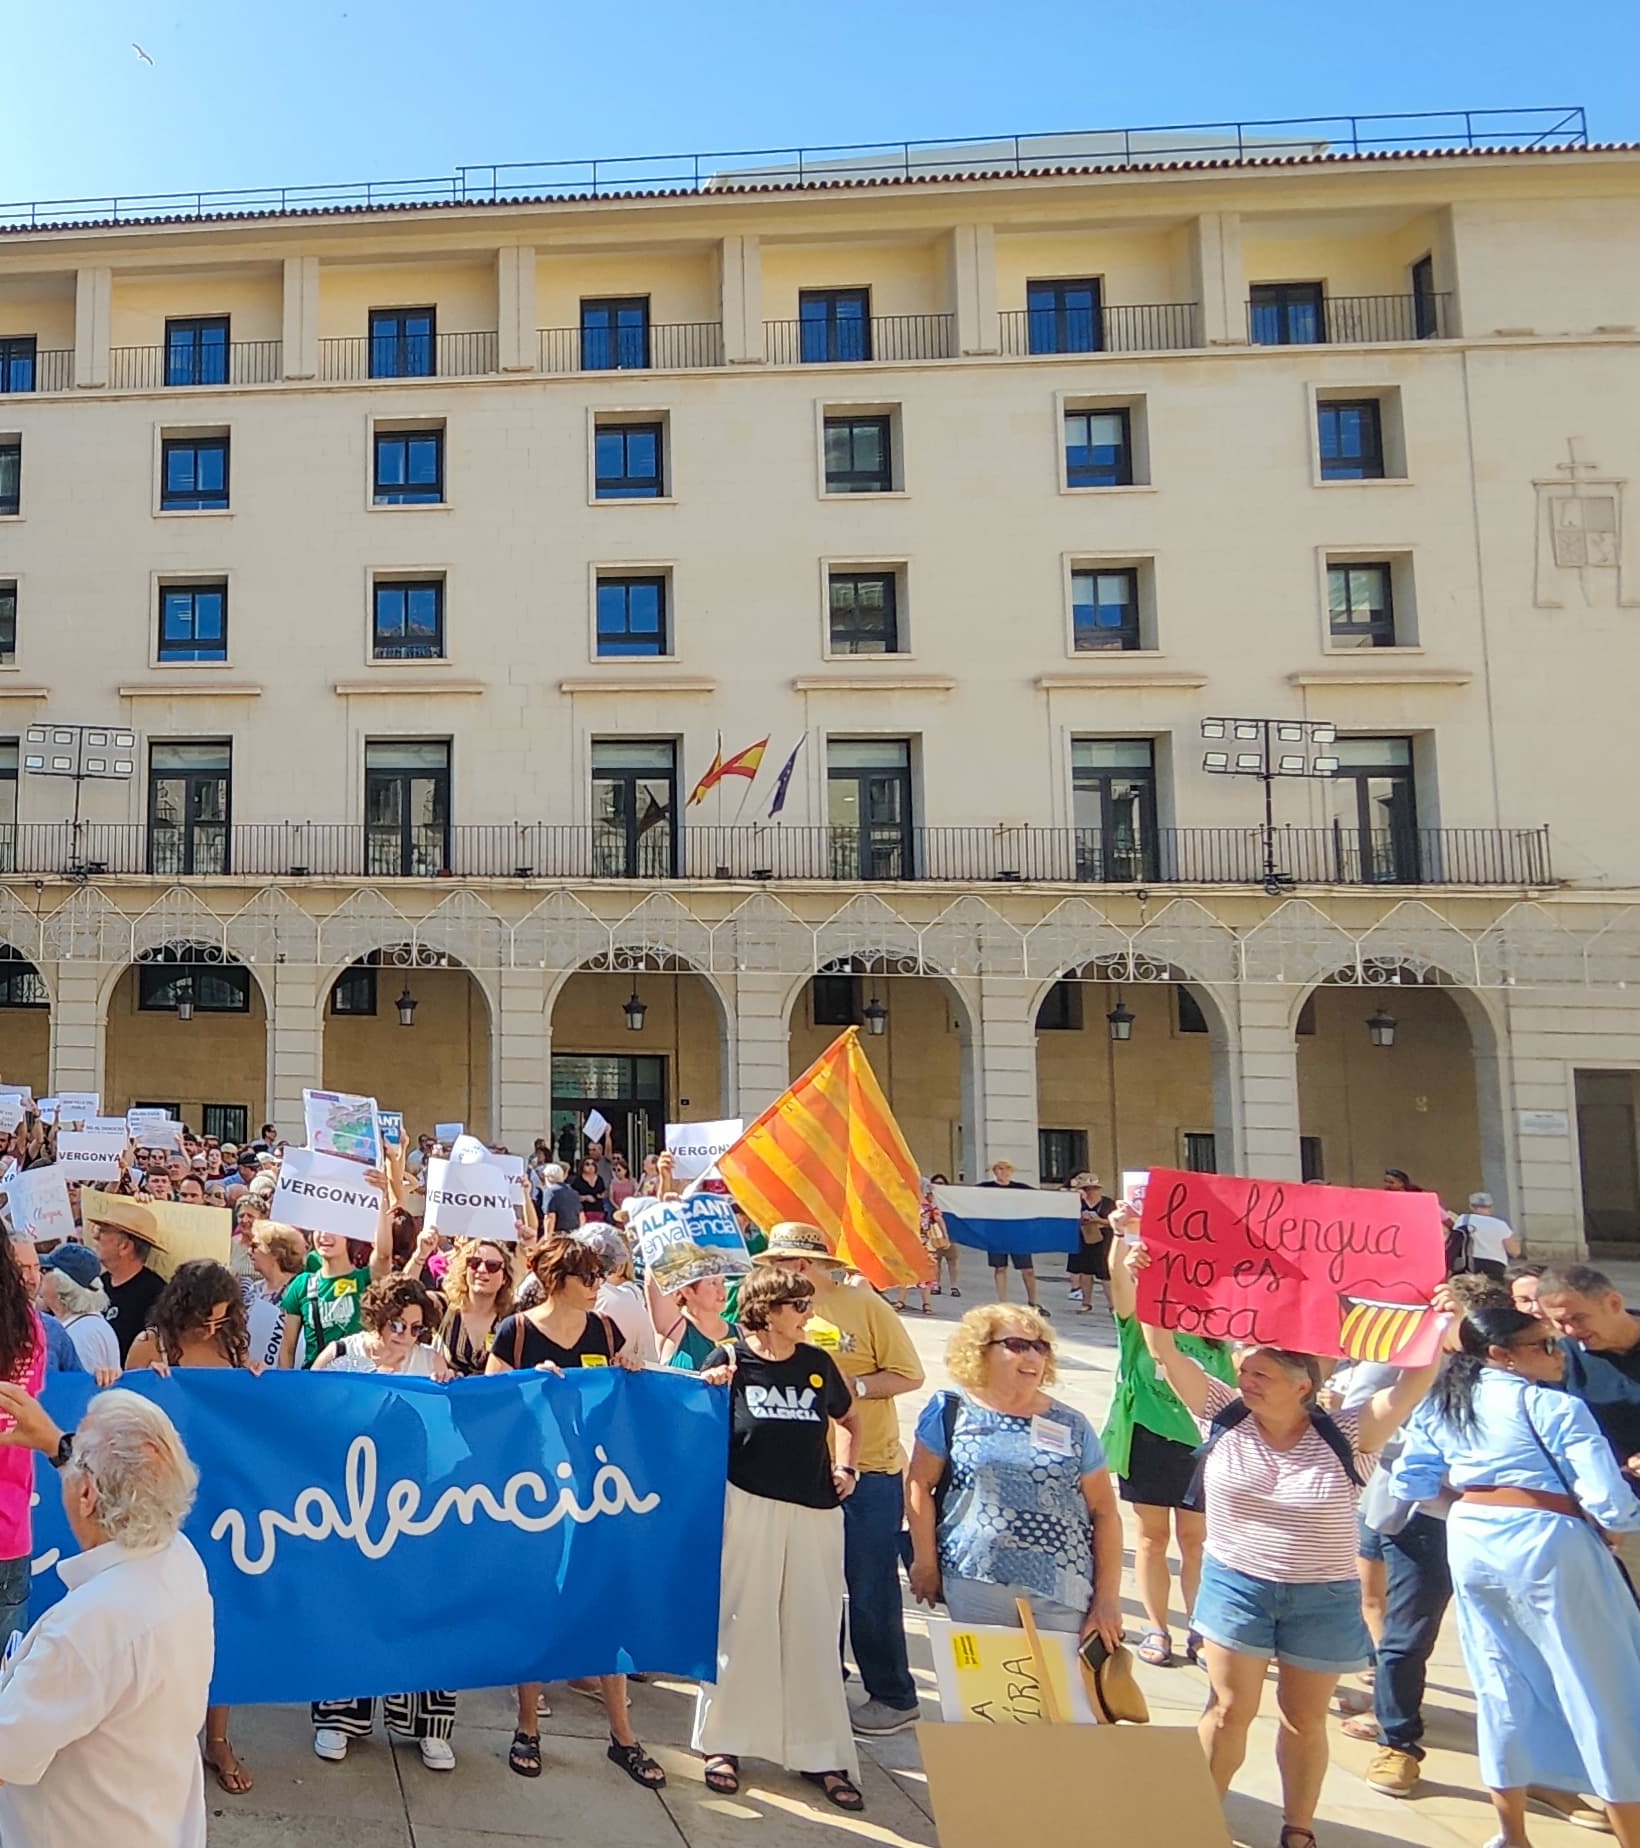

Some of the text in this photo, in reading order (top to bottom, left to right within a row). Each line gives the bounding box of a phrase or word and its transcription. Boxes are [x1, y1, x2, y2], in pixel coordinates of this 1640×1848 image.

[59, 1151, 120, 1163] VERGONYA
[280, 1177, 379, 1210] VERGONYA
[427, 1190, 512, 1208] VERGONY
[1157, 1183, 1404, 1284] la llengua
[1157, 1250, 1286, 1293] no es
[1153, 1276, 1278, 1344] toca
[211, 1436, 660, 1575] valencià
